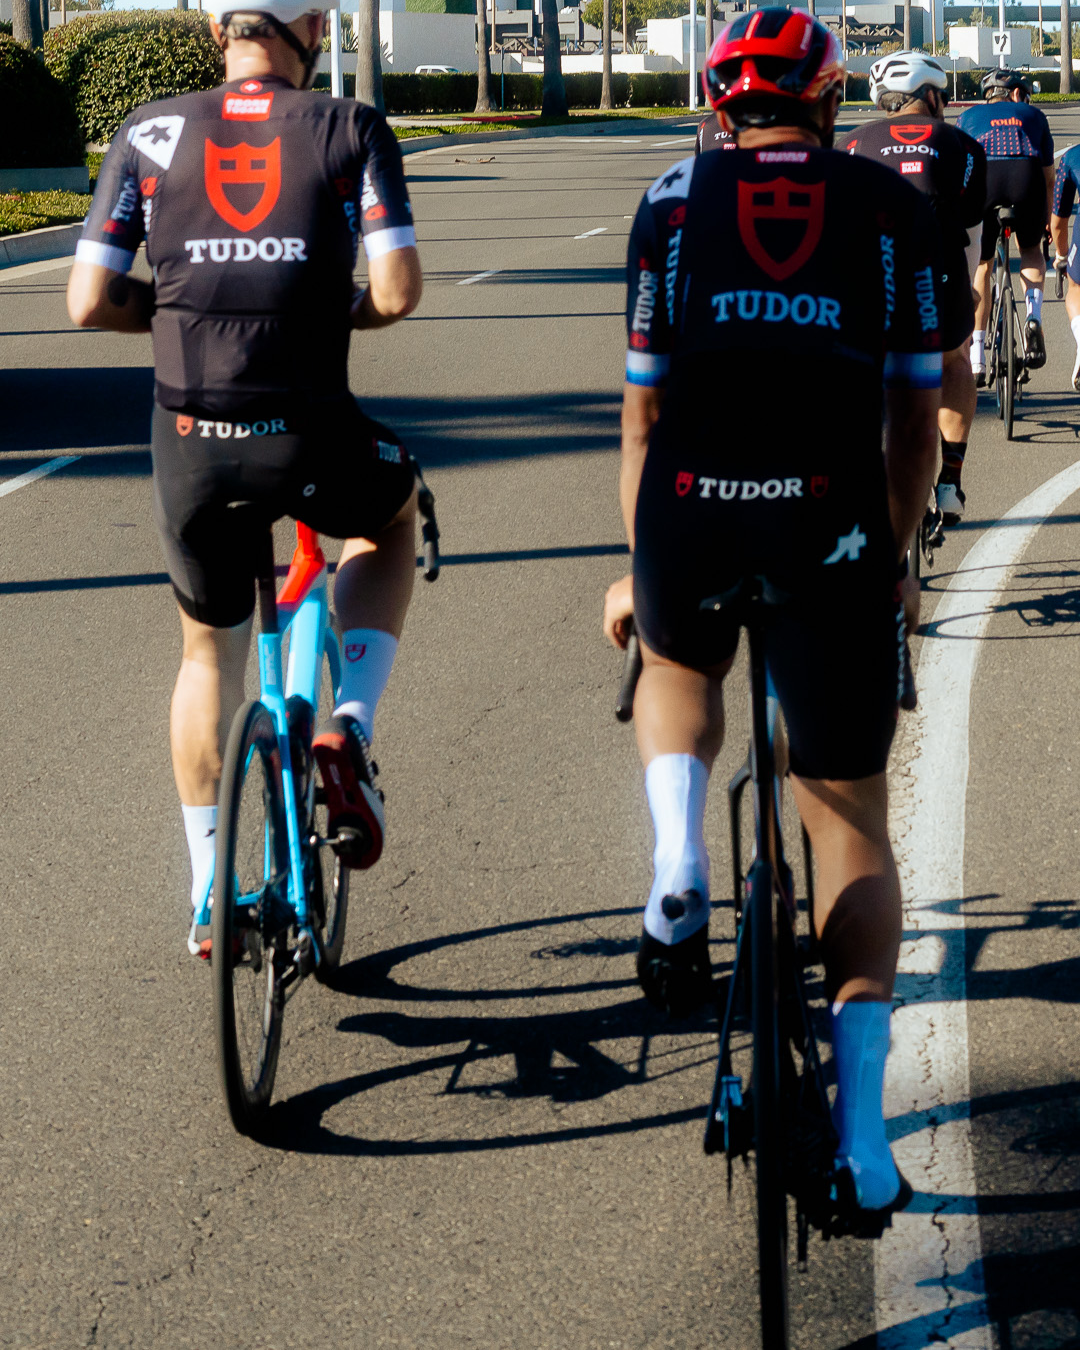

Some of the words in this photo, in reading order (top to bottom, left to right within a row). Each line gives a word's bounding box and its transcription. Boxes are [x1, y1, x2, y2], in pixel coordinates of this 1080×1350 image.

[880, 144, 939, 159] TUDOR
[111, 177, 137, 222] TUDO
[184, 237, 307, 263] TUDOR
[632, 270, 659, 332] TUDOR
[711, 290, 841, 330] TUDOR
[914, 266, 939, 332] TUDOR
[198, 418, 287, 439] TUDOR
[698, 476, 803, 500] TUDOR
